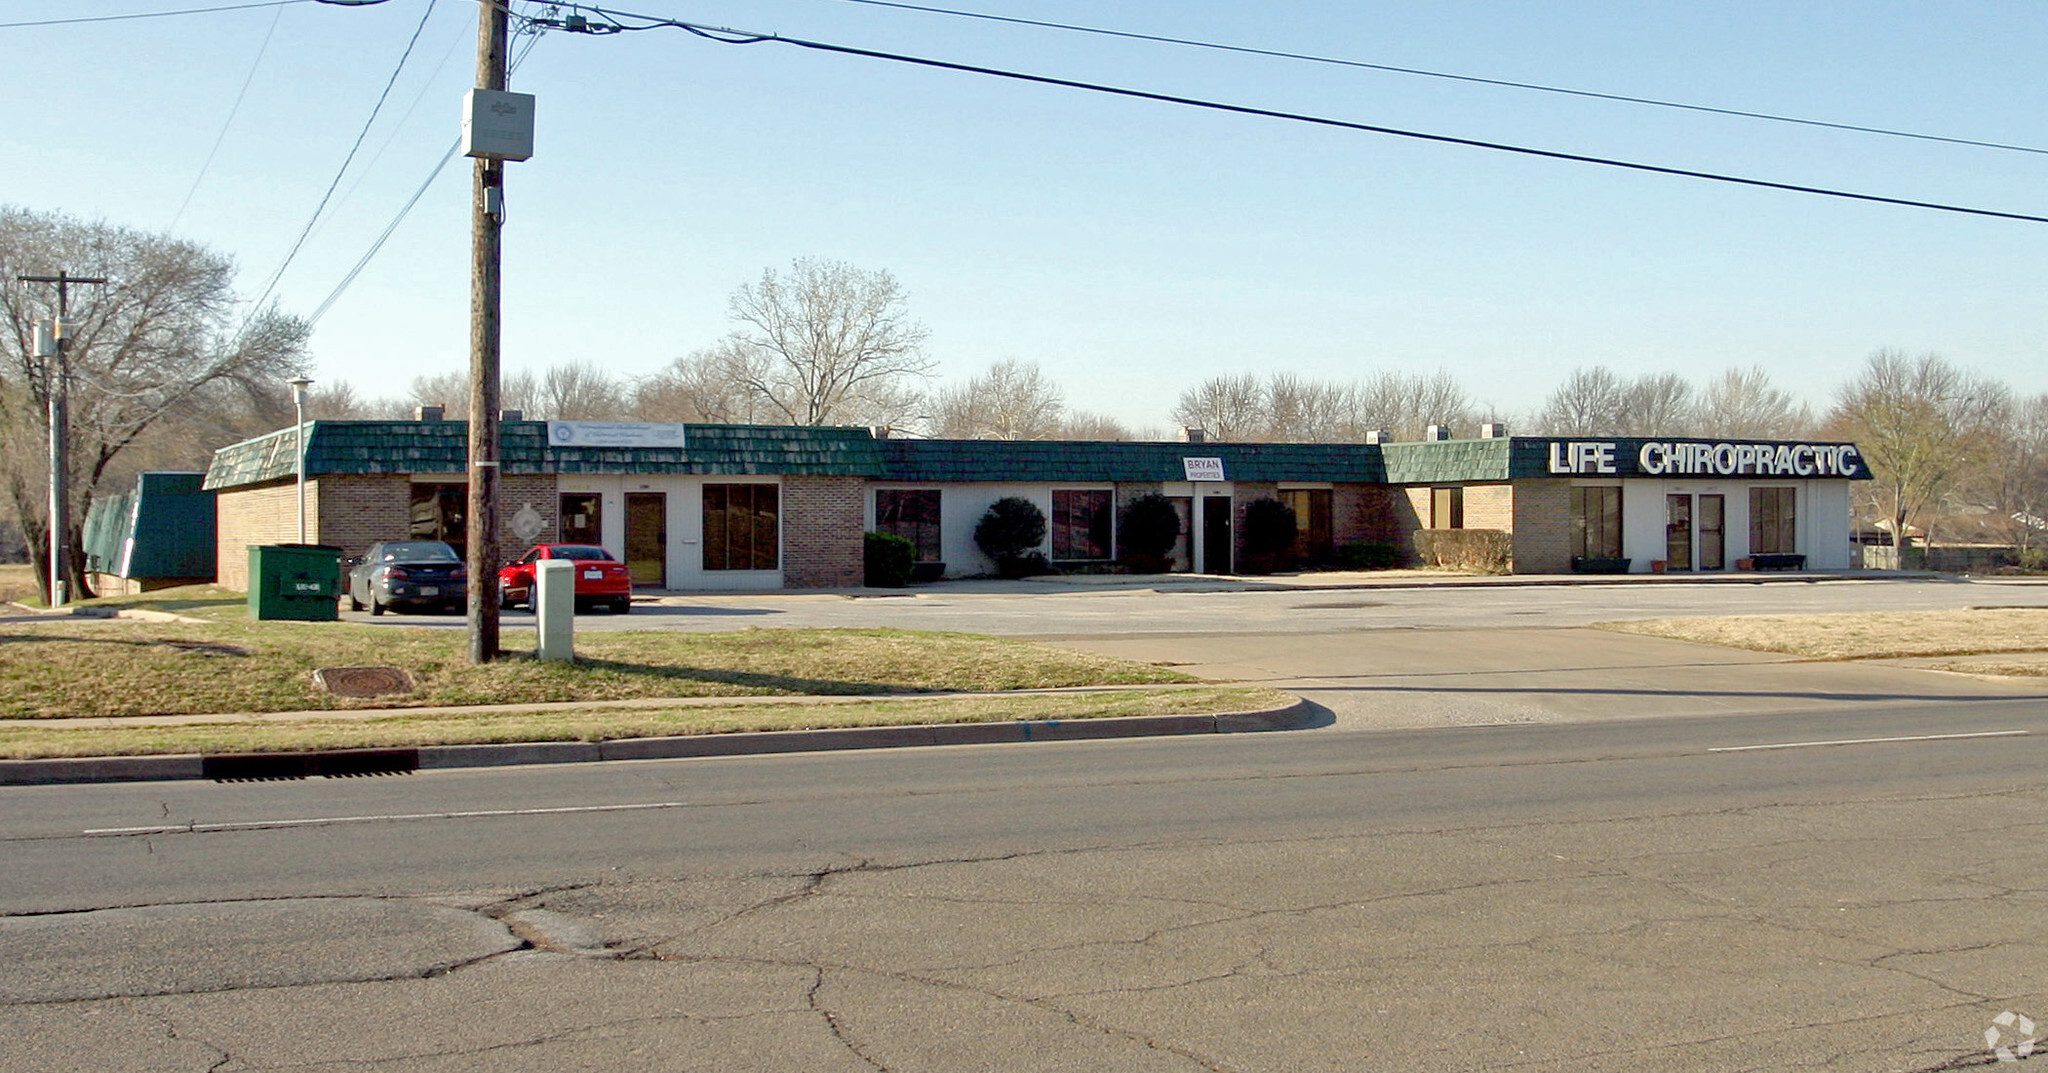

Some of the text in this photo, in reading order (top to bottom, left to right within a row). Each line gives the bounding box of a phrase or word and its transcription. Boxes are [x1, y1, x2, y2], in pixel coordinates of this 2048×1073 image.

[1188, 460, 1219, 469] BRYAN
[1549, 441, 1858, 475] LIFE CHIROPRACTIC
